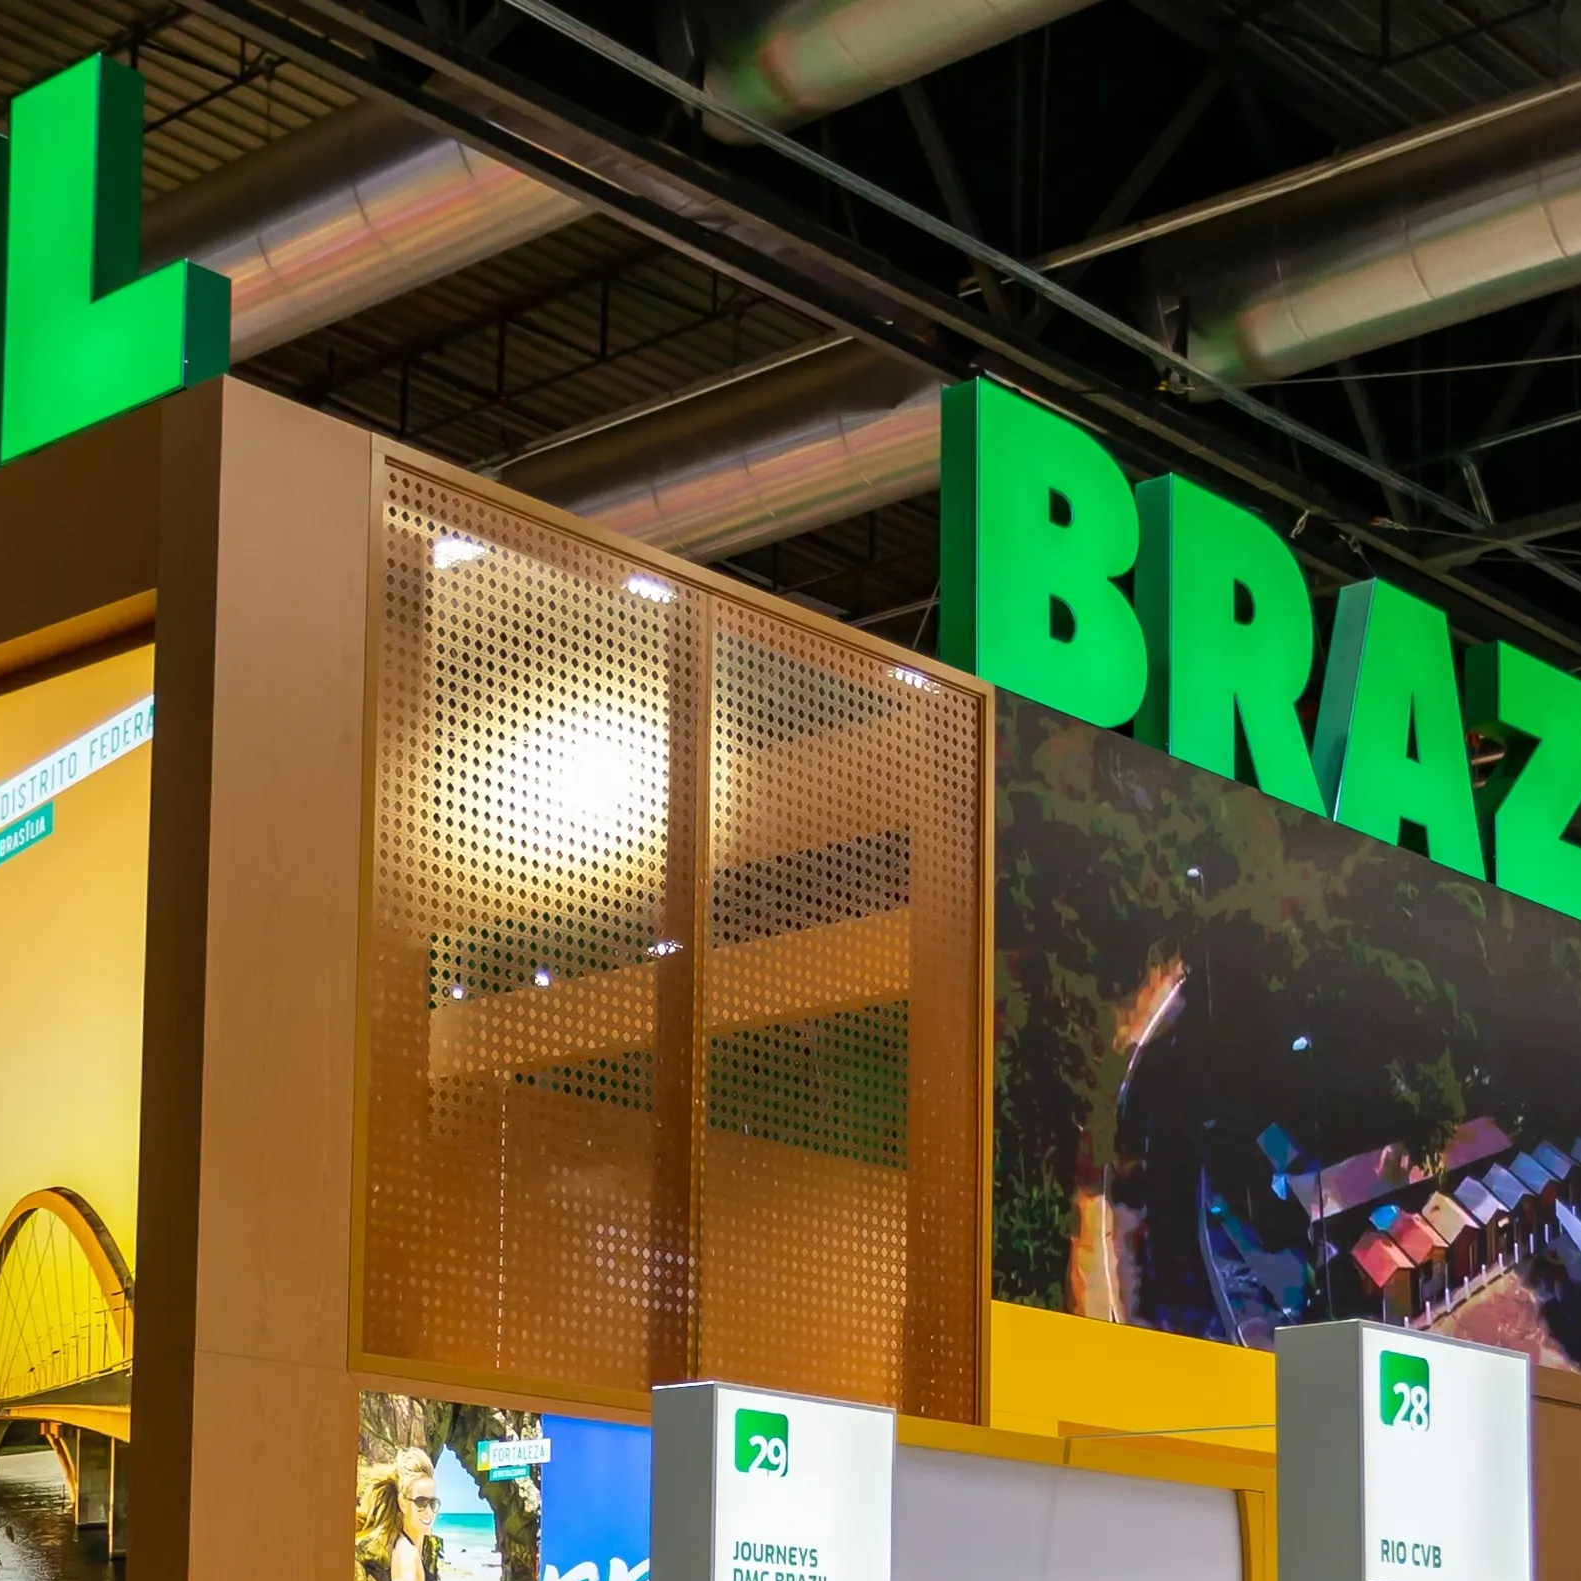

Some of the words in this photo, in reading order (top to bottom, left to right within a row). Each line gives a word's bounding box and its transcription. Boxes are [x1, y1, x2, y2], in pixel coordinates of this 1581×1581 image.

[0, 752, 78, 822] DISTRITO
[1392, 1381, 1429, 1432] 28
[492, 1445, 545, 1463] FORTALEZA
[749, 1434, 788, 1477] 29
[733, 1541, 819, 1568] JOURNEYS
[1380, 1539, 1407, 1565] RIO
[1411, 1543, 1442, 1569] CVB
